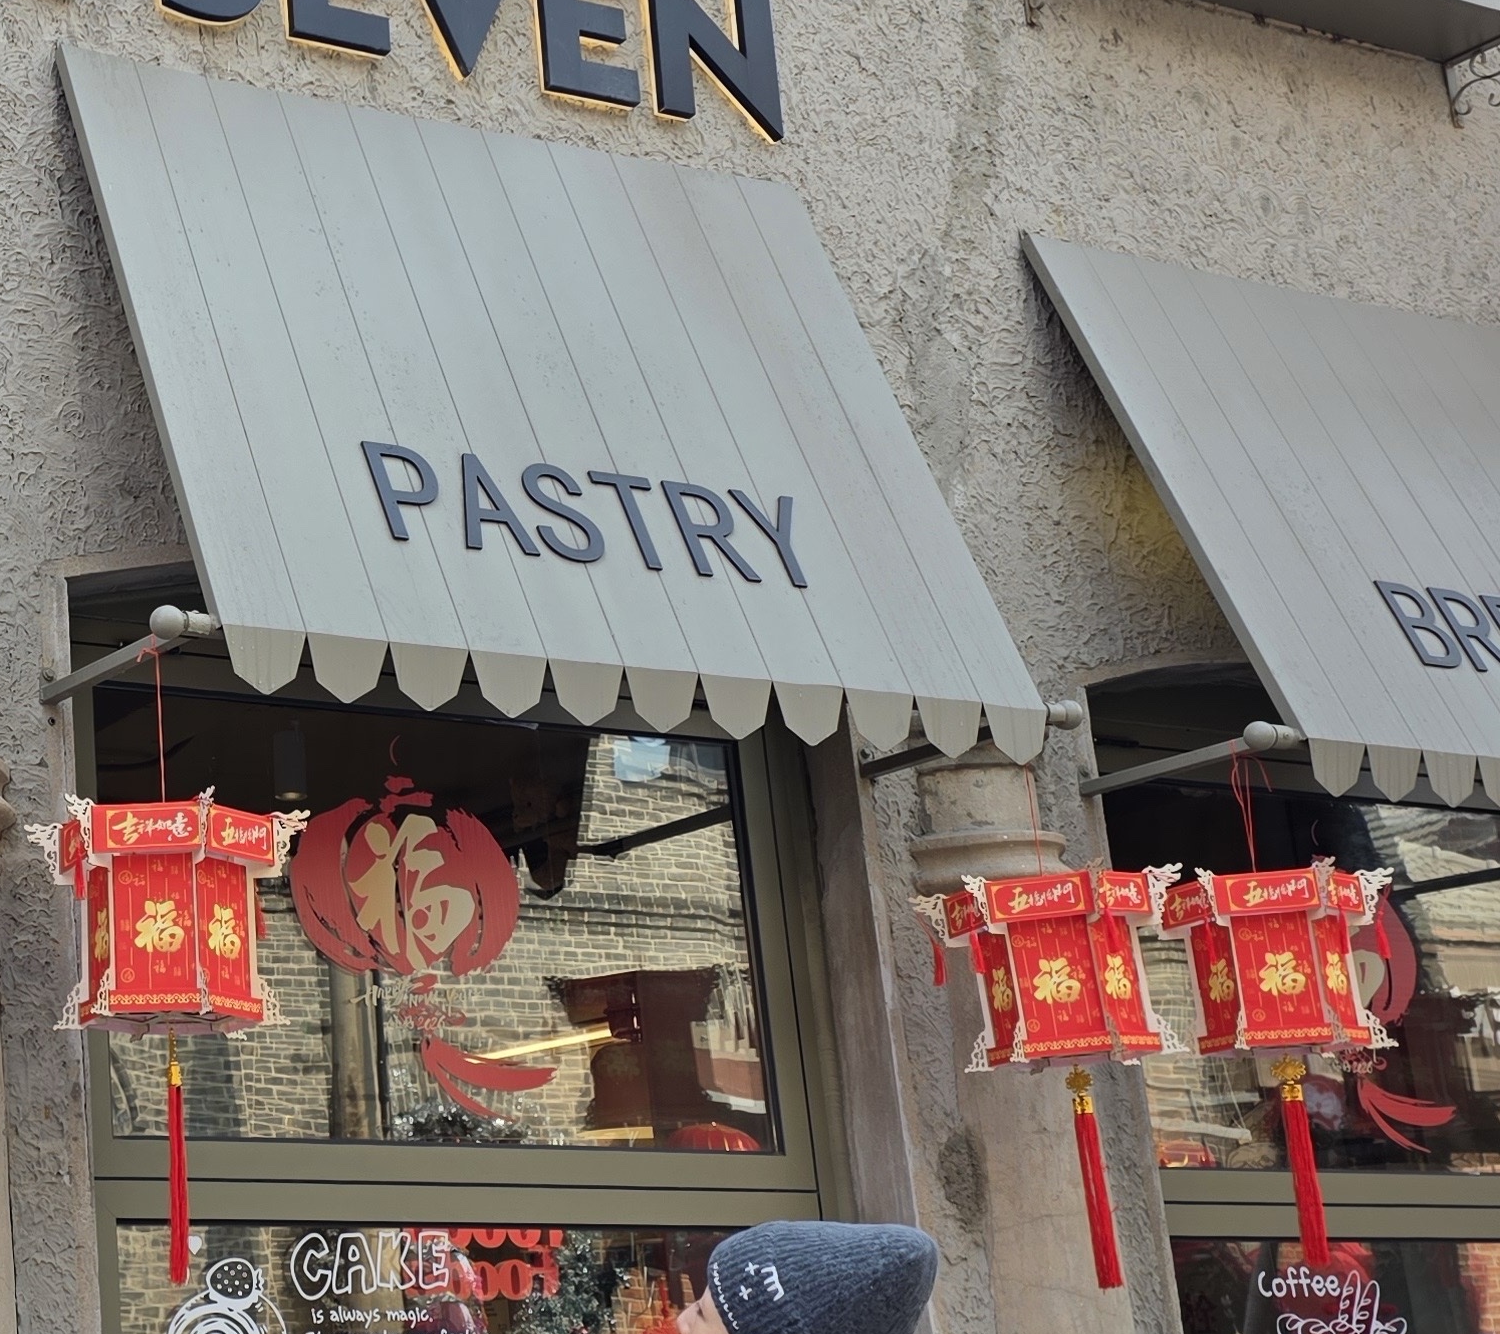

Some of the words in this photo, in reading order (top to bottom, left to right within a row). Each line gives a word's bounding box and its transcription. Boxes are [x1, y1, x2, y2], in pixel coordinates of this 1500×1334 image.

[361, 440, 808, 589] PASTRY
[348, 812, 475, 969] 福
[134, 899, 185, 953] 福
[208, 903, 242, 959] 福
[1033, 957, 1081, 1004] 福
[1105, 953, 1132, 1000] 福
[1259, 952, 1306, 996] 福
[1326, 950, 1348, 996] 福
[290, 1231, 450, 1301] CAKE
[1257, 1265, 1342, 1299] Coffee
[311, 1307, 325, 1325] is
[330, 1307, 381, 1329] always
[386, 1309, 434, 1330] magic.
